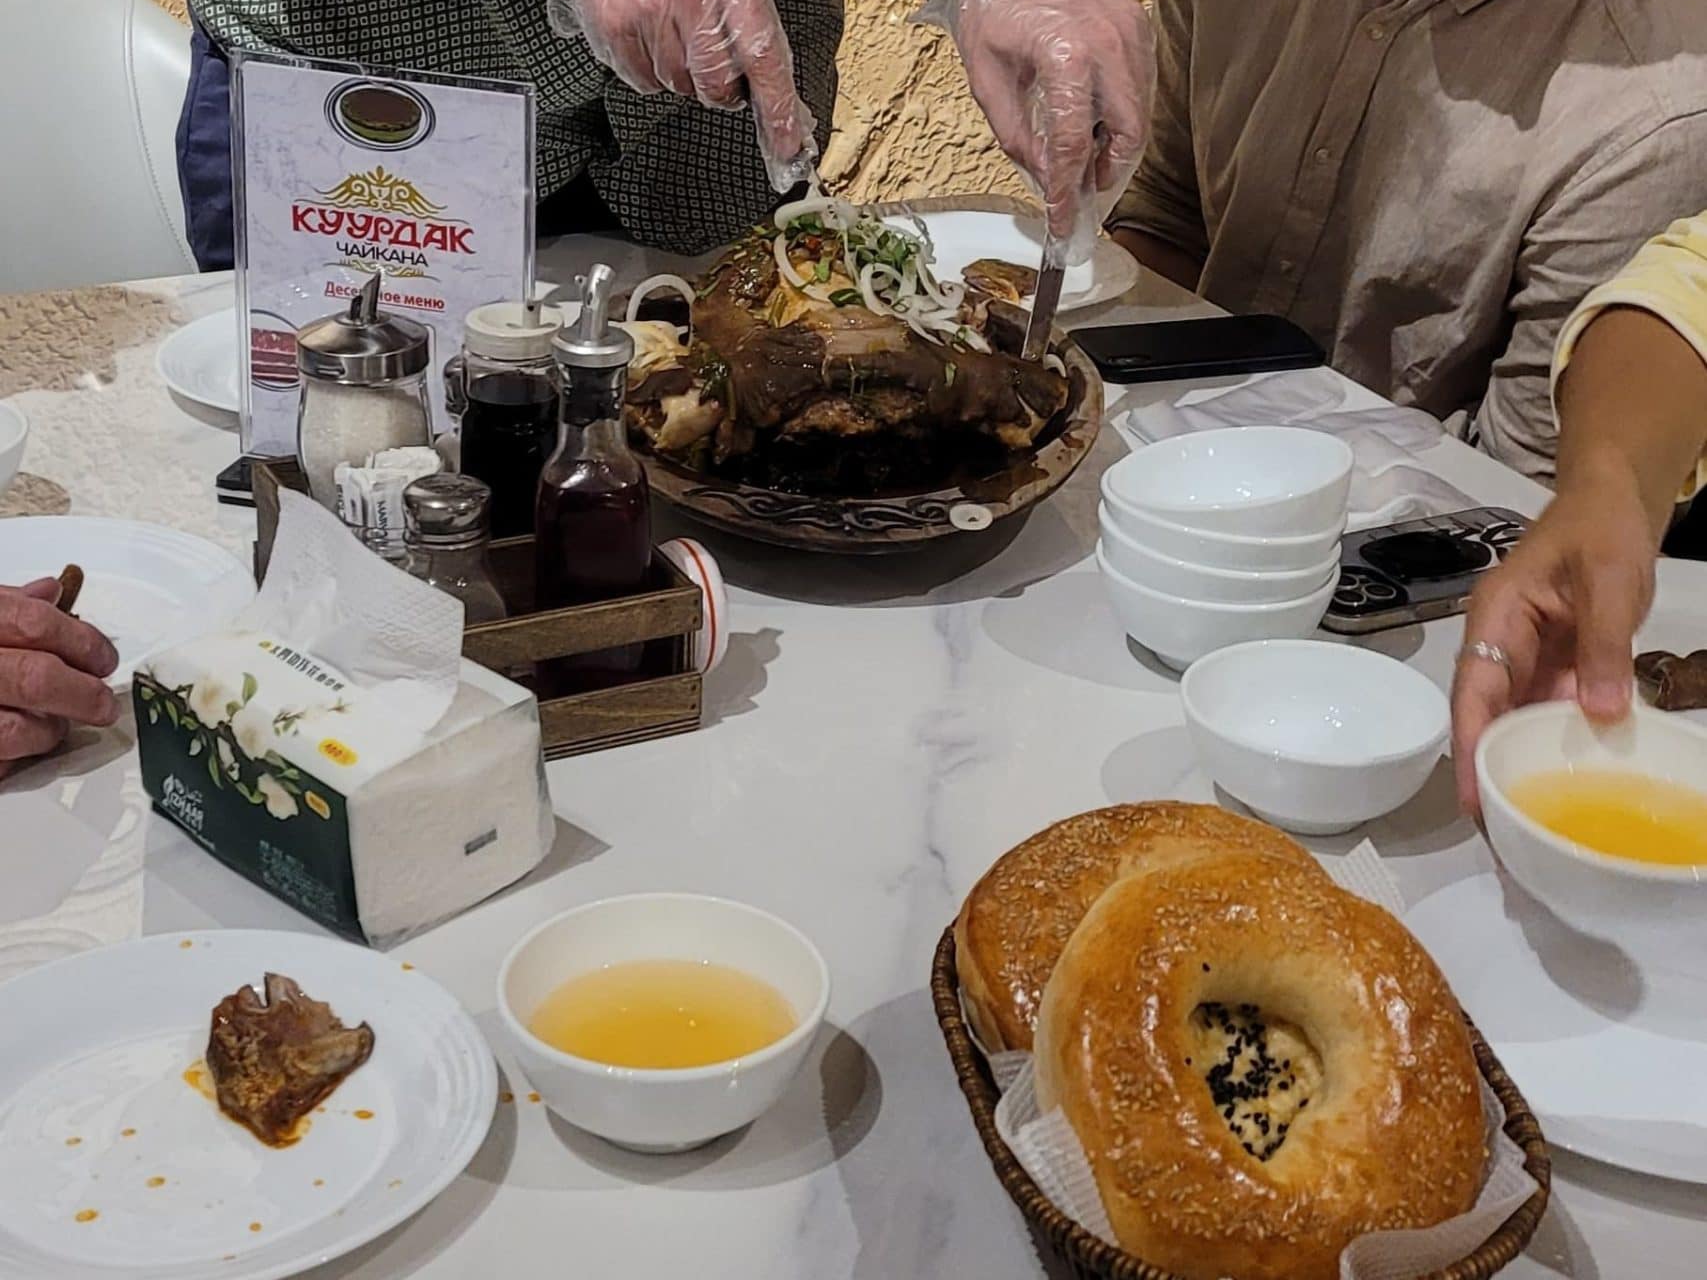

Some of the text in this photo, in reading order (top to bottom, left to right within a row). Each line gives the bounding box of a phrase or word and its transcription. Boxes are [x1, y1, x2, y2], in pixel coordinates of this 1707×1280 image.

[292, 205, 476, 254] КУУРДАК
[336, 241, 429, 267] ЧАЙКАНА
[324, 280, 445, 310] Десеое меню
